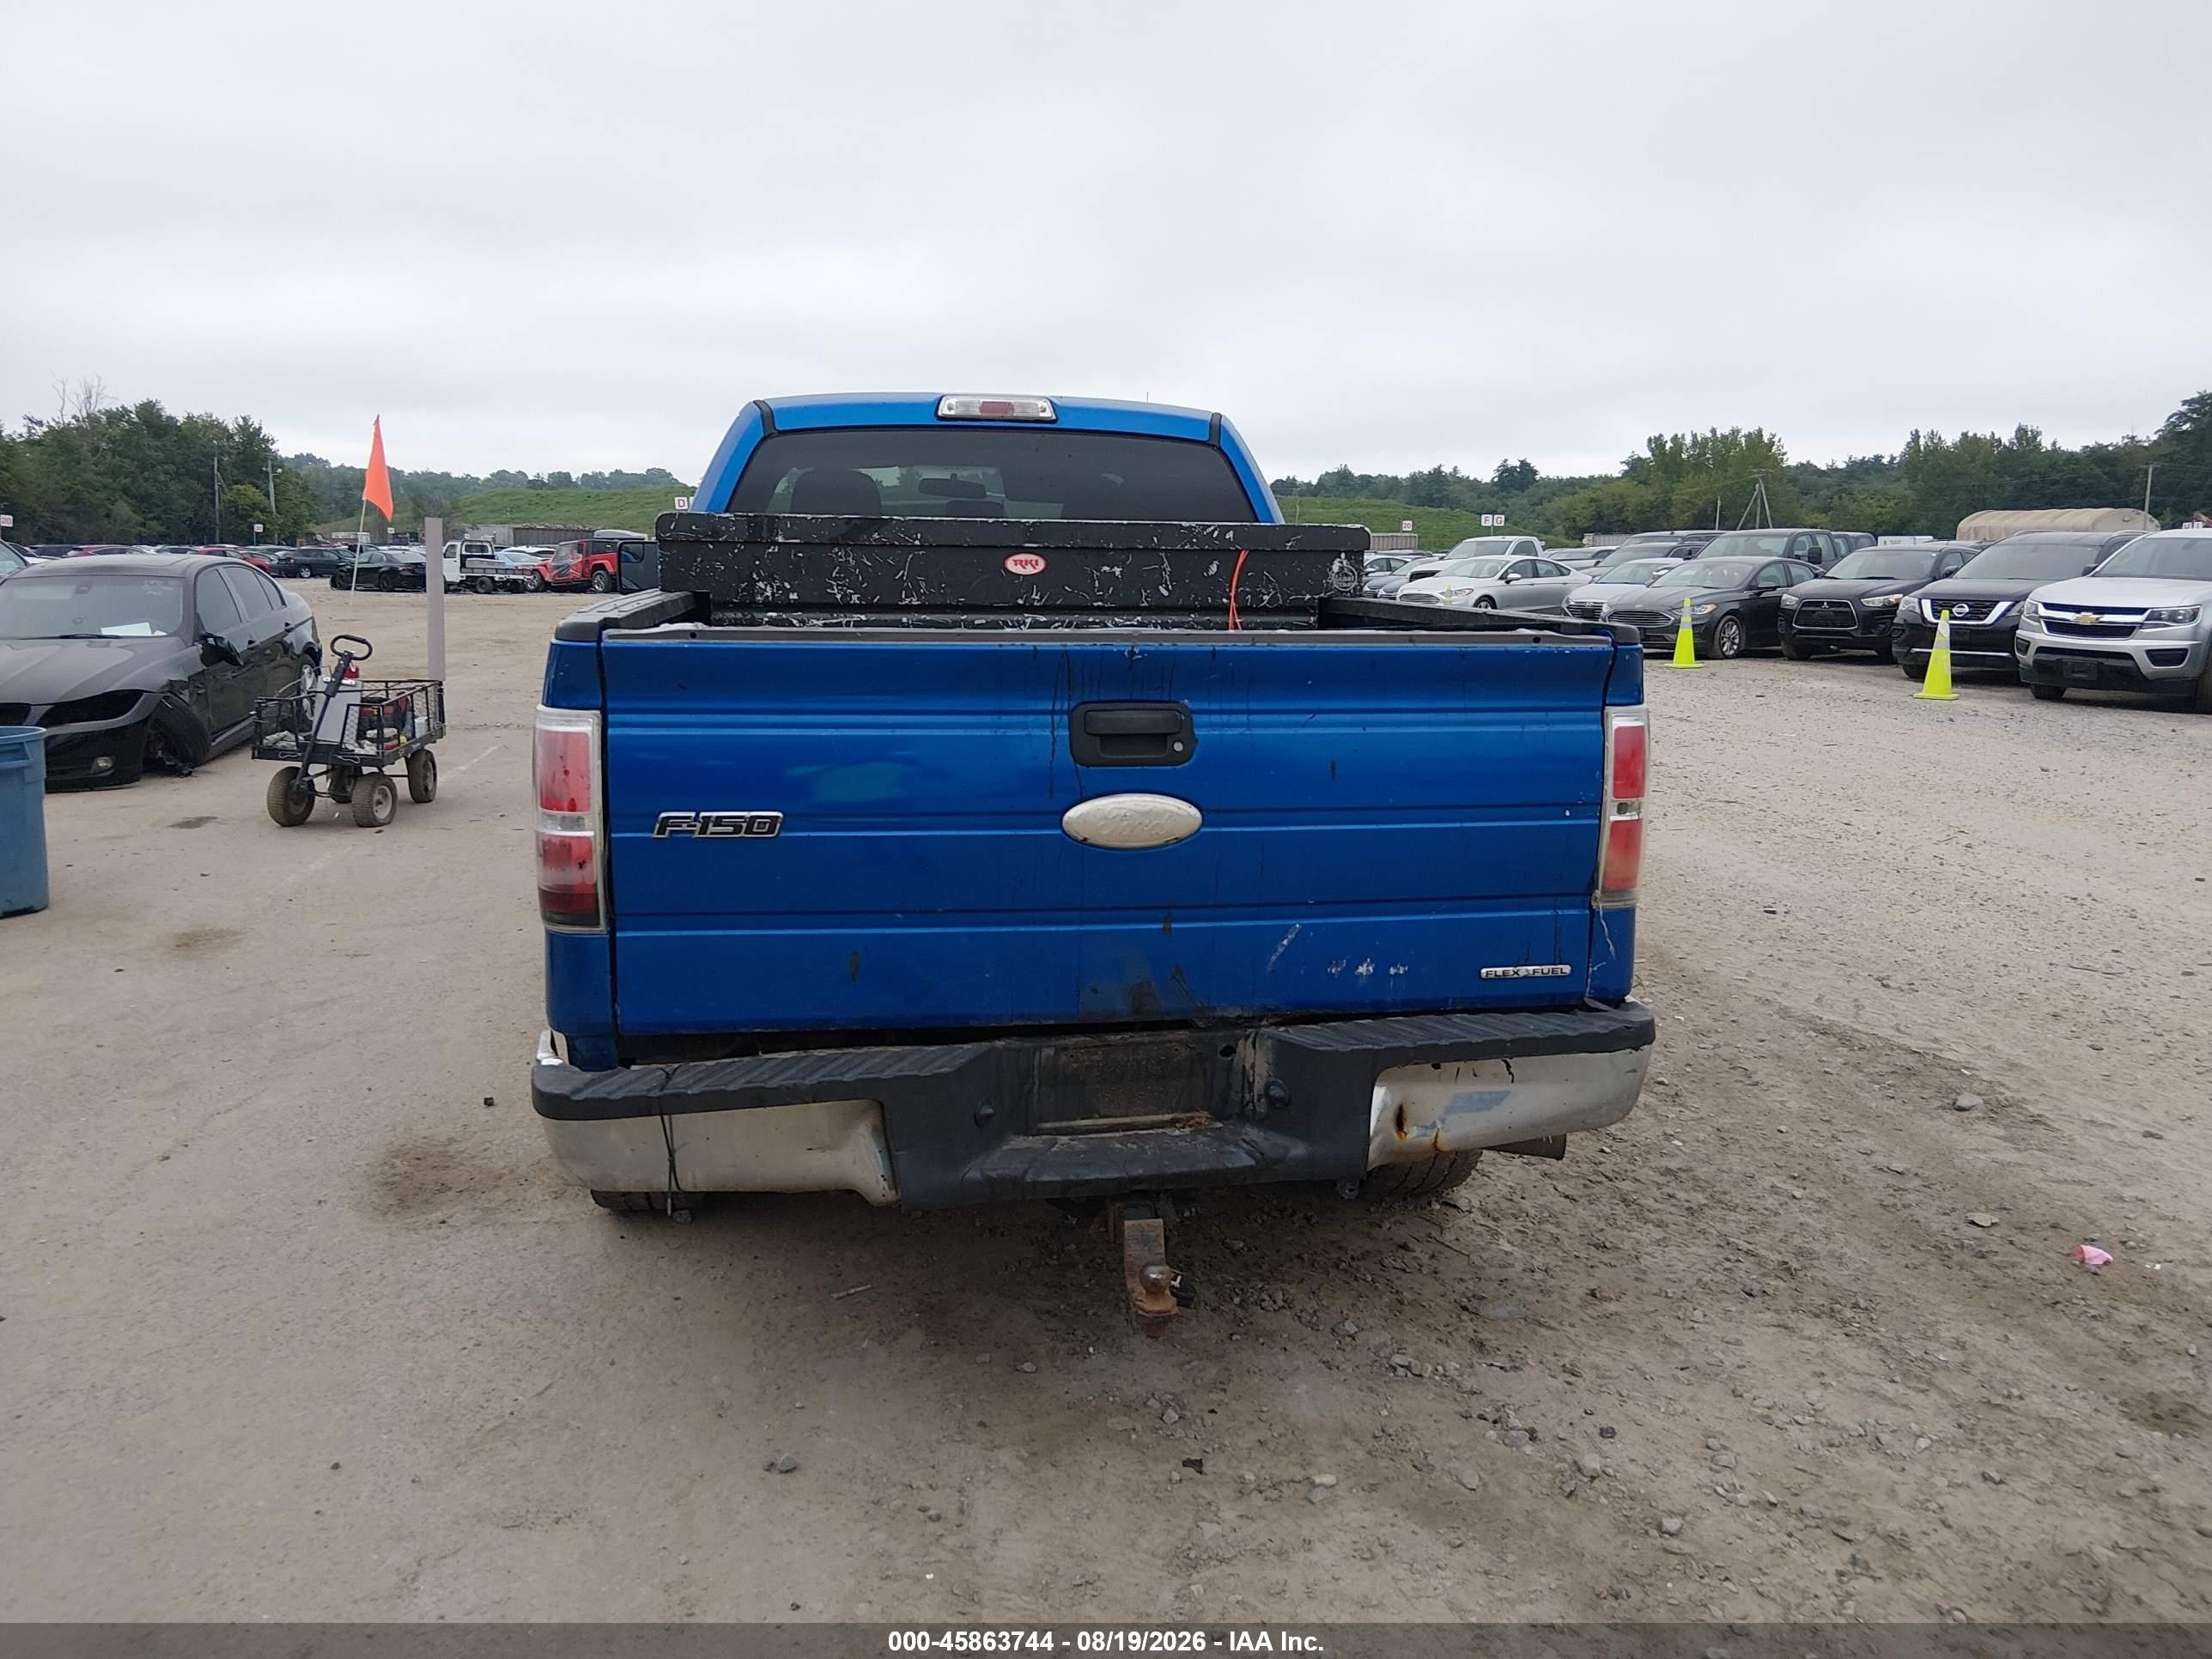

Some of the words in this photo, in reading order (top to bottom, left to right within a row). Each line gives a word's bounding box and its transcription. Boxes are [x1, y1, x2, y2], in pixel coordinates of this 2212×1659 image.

[678, 499, 685, 507] D
[1496, 516, 1503, 525] G
[653, 811, 784, 838] F-150
[1485, 969, 1520, 978] FLEX
[1532, 967, 1568, 975] FUEL
